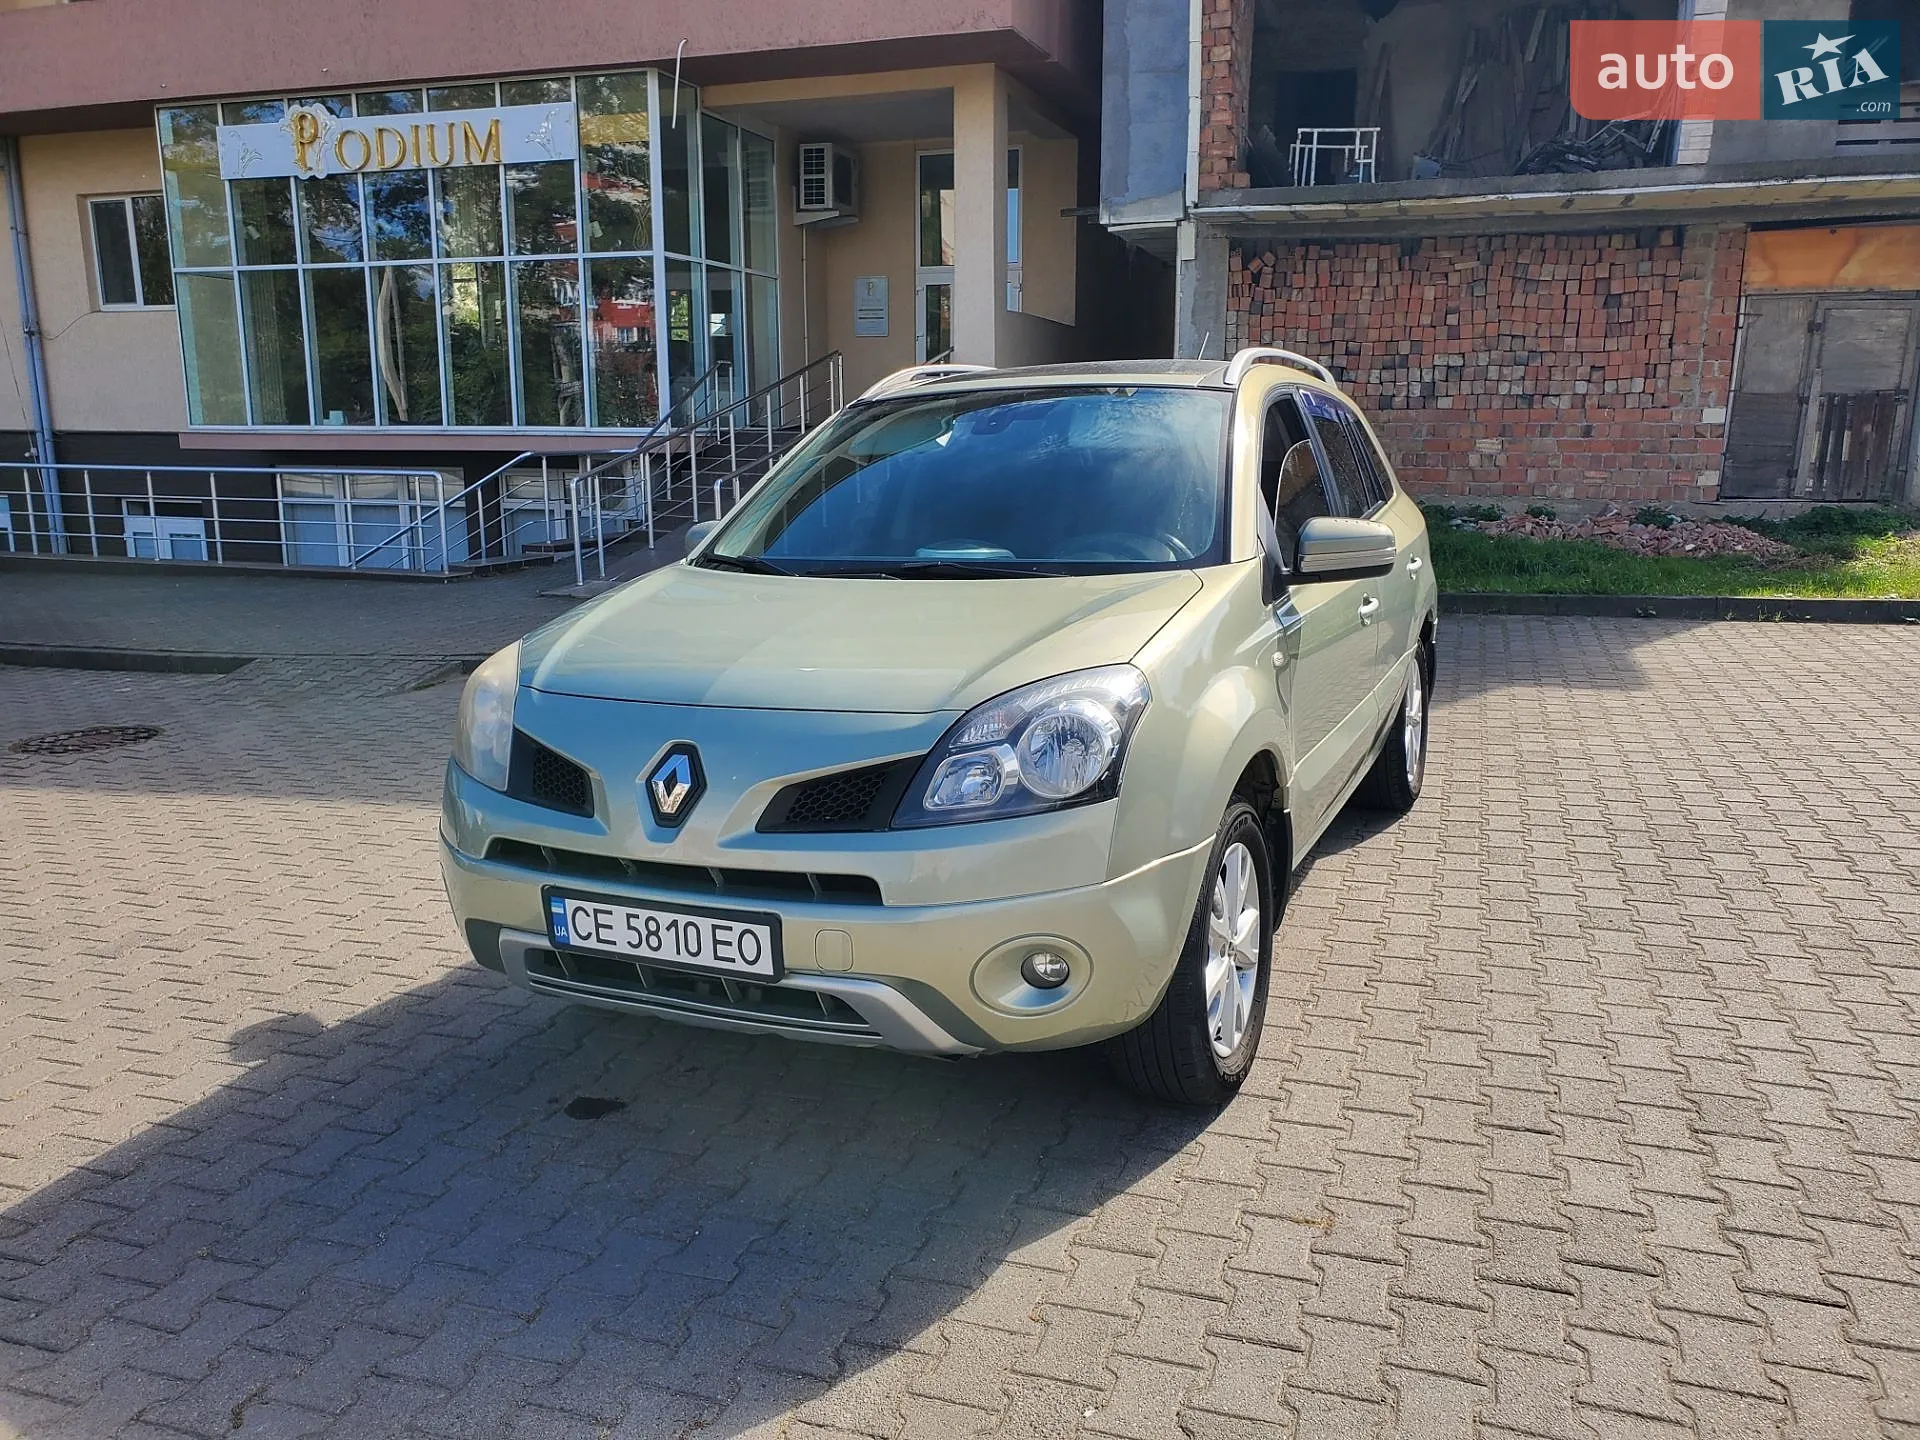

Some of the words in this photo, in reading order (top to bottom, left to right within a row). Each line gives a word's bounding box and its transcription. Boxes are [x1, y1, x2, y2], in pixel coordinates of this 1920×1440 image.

[293, 111, 501, 172] PODIUM
[554, 924, 568, 937] UA
[571, 906, 617, 946] CE
[625, 912, 702, 958] 5810
[711, 924, 762, 966] EO
